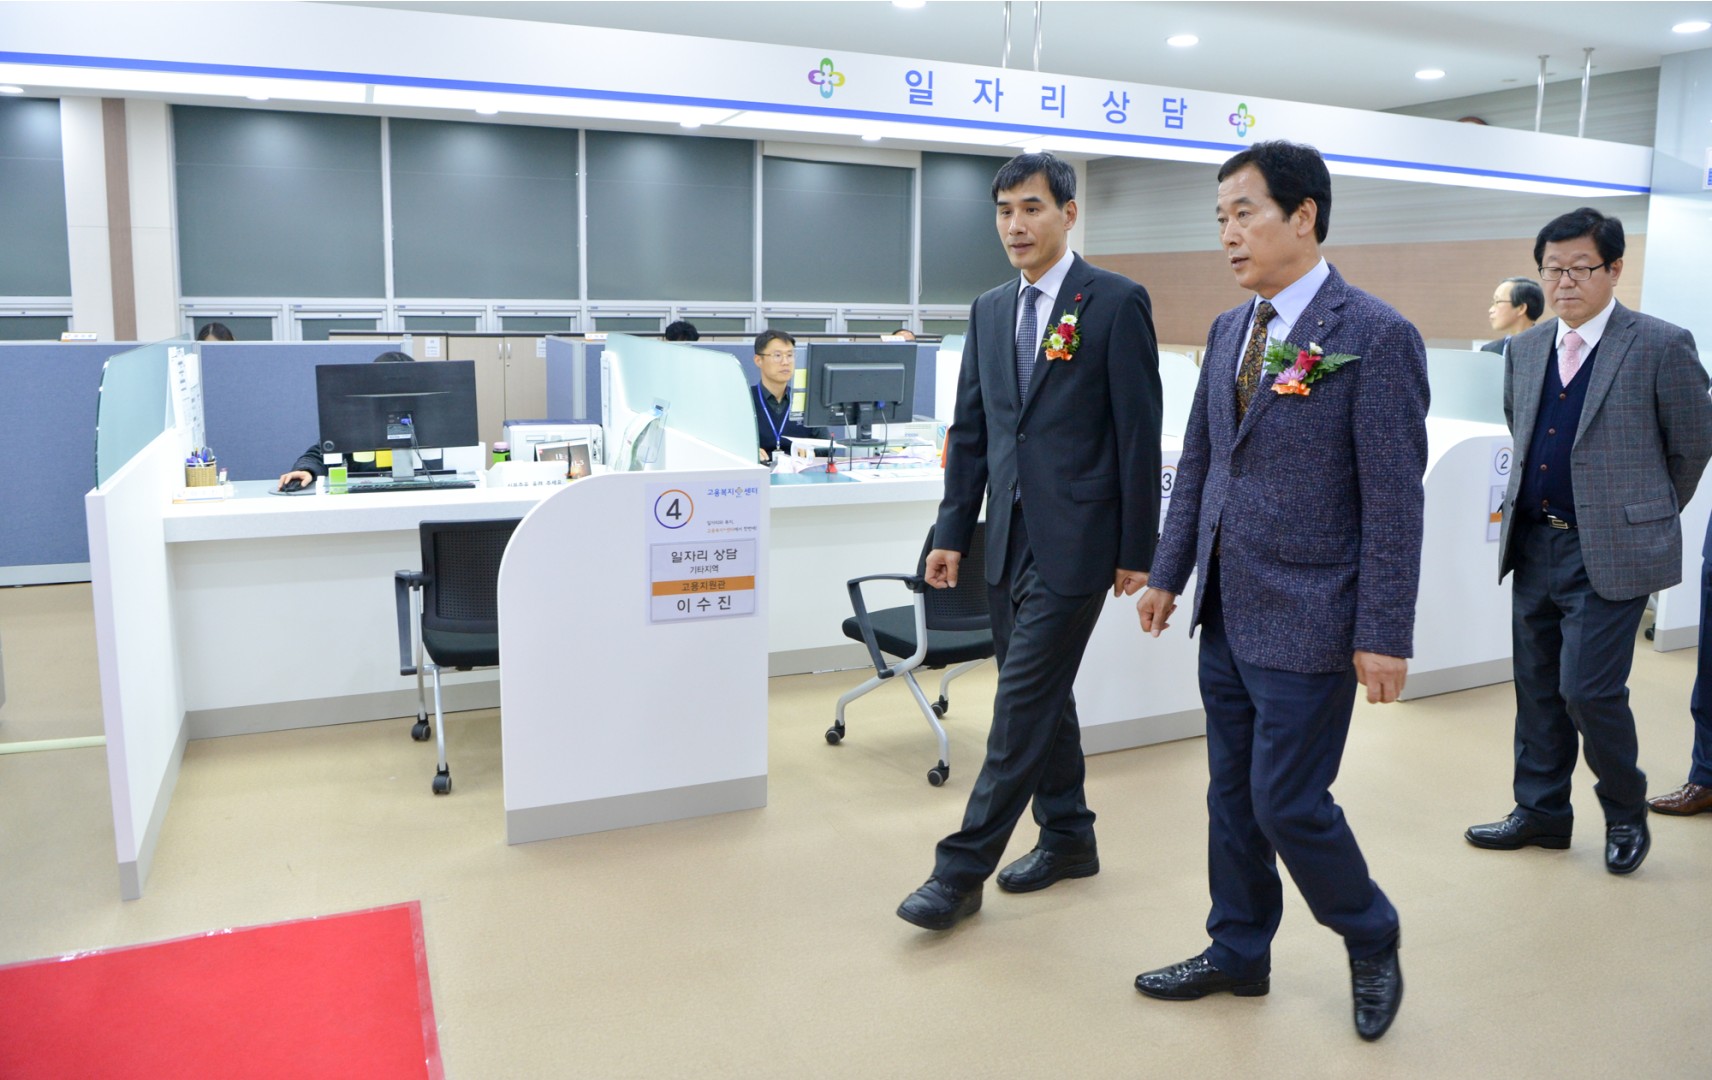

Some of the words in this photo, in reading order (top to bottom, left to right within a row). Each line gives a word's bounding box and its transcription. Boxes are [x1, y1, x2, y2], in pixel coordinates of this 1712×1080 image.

[1500, 453, 1509, 470] 2
[1162, 472, 1172, 491] 3
[666, 498, 682, 520] 4
[671, 550, 708, 564] 일자리
[713, 548, 738, 561] 상담
[690, 564, 719, 574] 기타지역
[681, 580, 726, 592] 고용지원관
